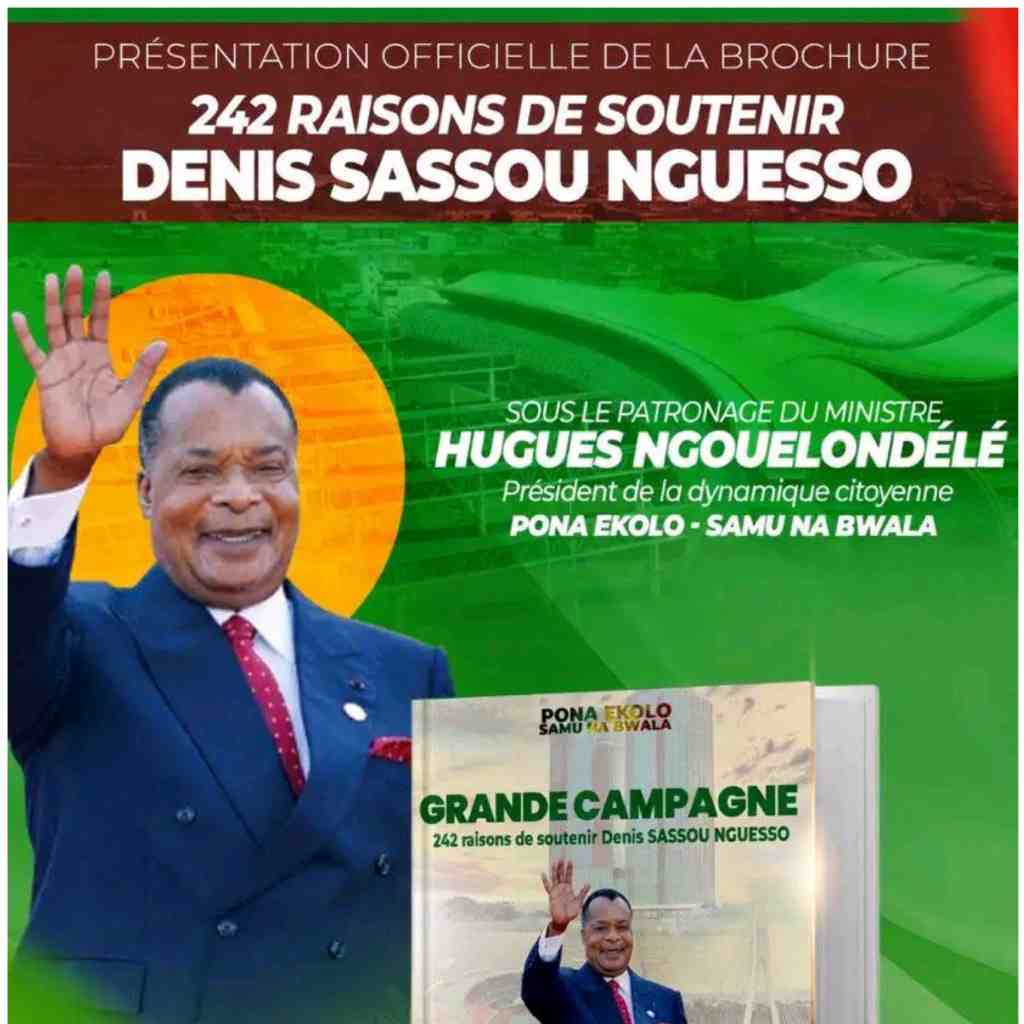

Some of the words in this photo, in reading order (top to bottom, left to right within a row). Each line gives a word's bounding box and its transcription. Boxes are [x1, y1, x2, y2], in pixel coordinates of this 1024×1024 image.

[94, 38, 369, 70] PRÉSENTATION
[381, 42, 590, 70] OFFICIELLE
[603, 43, 651, 70] DE
[666, 43, 709, 70] LA
[721, 43, 930, 70] BROCHURE
[188, 95, 277, 135] 242
[287, 94, 507, 135] RAISONS
[516, 94, 588, 135] DE
[595, 94, 845, 135] SOUTENIR
[122, 148, 316, 202] DENIS
[330, 148, 589, 203] SASSOU
[607, 148, 913, 203] NGUESSO
[506, 400, 576, 423] SOUS
[581, 400, 612, 423] LE
[617, 400, 774, 423] PATRONAGE
[780, 401, 818, 423] DU
[825, 400, 942, 423] MINISTRE
[435, 430, 623, 469] HUGUES
[632, 420, 1008, 468] NGOUELONDÉLÉ
[503, 478, 618, 502] Président
[622, 478, 654, 502] de
[660, 478, 683, 502] la
[687, 478, 830, 508] dynamique
[835, 478, 954, 508] citoyenne
[510, 514, 588, 537] PONA
[594, 514, 685, 537] EKOLO
[705, 514, 785, 537] SAMU
[790, 515, 829, 537] NA
[835, 515, 937, 537] BWALA
[539, 721, 583, 736] SAMU
[613, 718, 672, 733] BWALA
[541, 705, 598, 723] PONA
[604, 702, 672, 721] EKOLO
[419, 790, 569, 825] GRANDE
[573, 783, 799, 821] CAMPAGNE
[432, 833, 458, 848] 242
[461, 831, 512, 848] raisons
[515, 830, 534, 846] de
[536, 828, 598, 847] soutenir
[602, 827, 645, 845] Denis
[647, 827, 710, 844] SASSOU
[714, 825, 791, 843] NGUESSO
